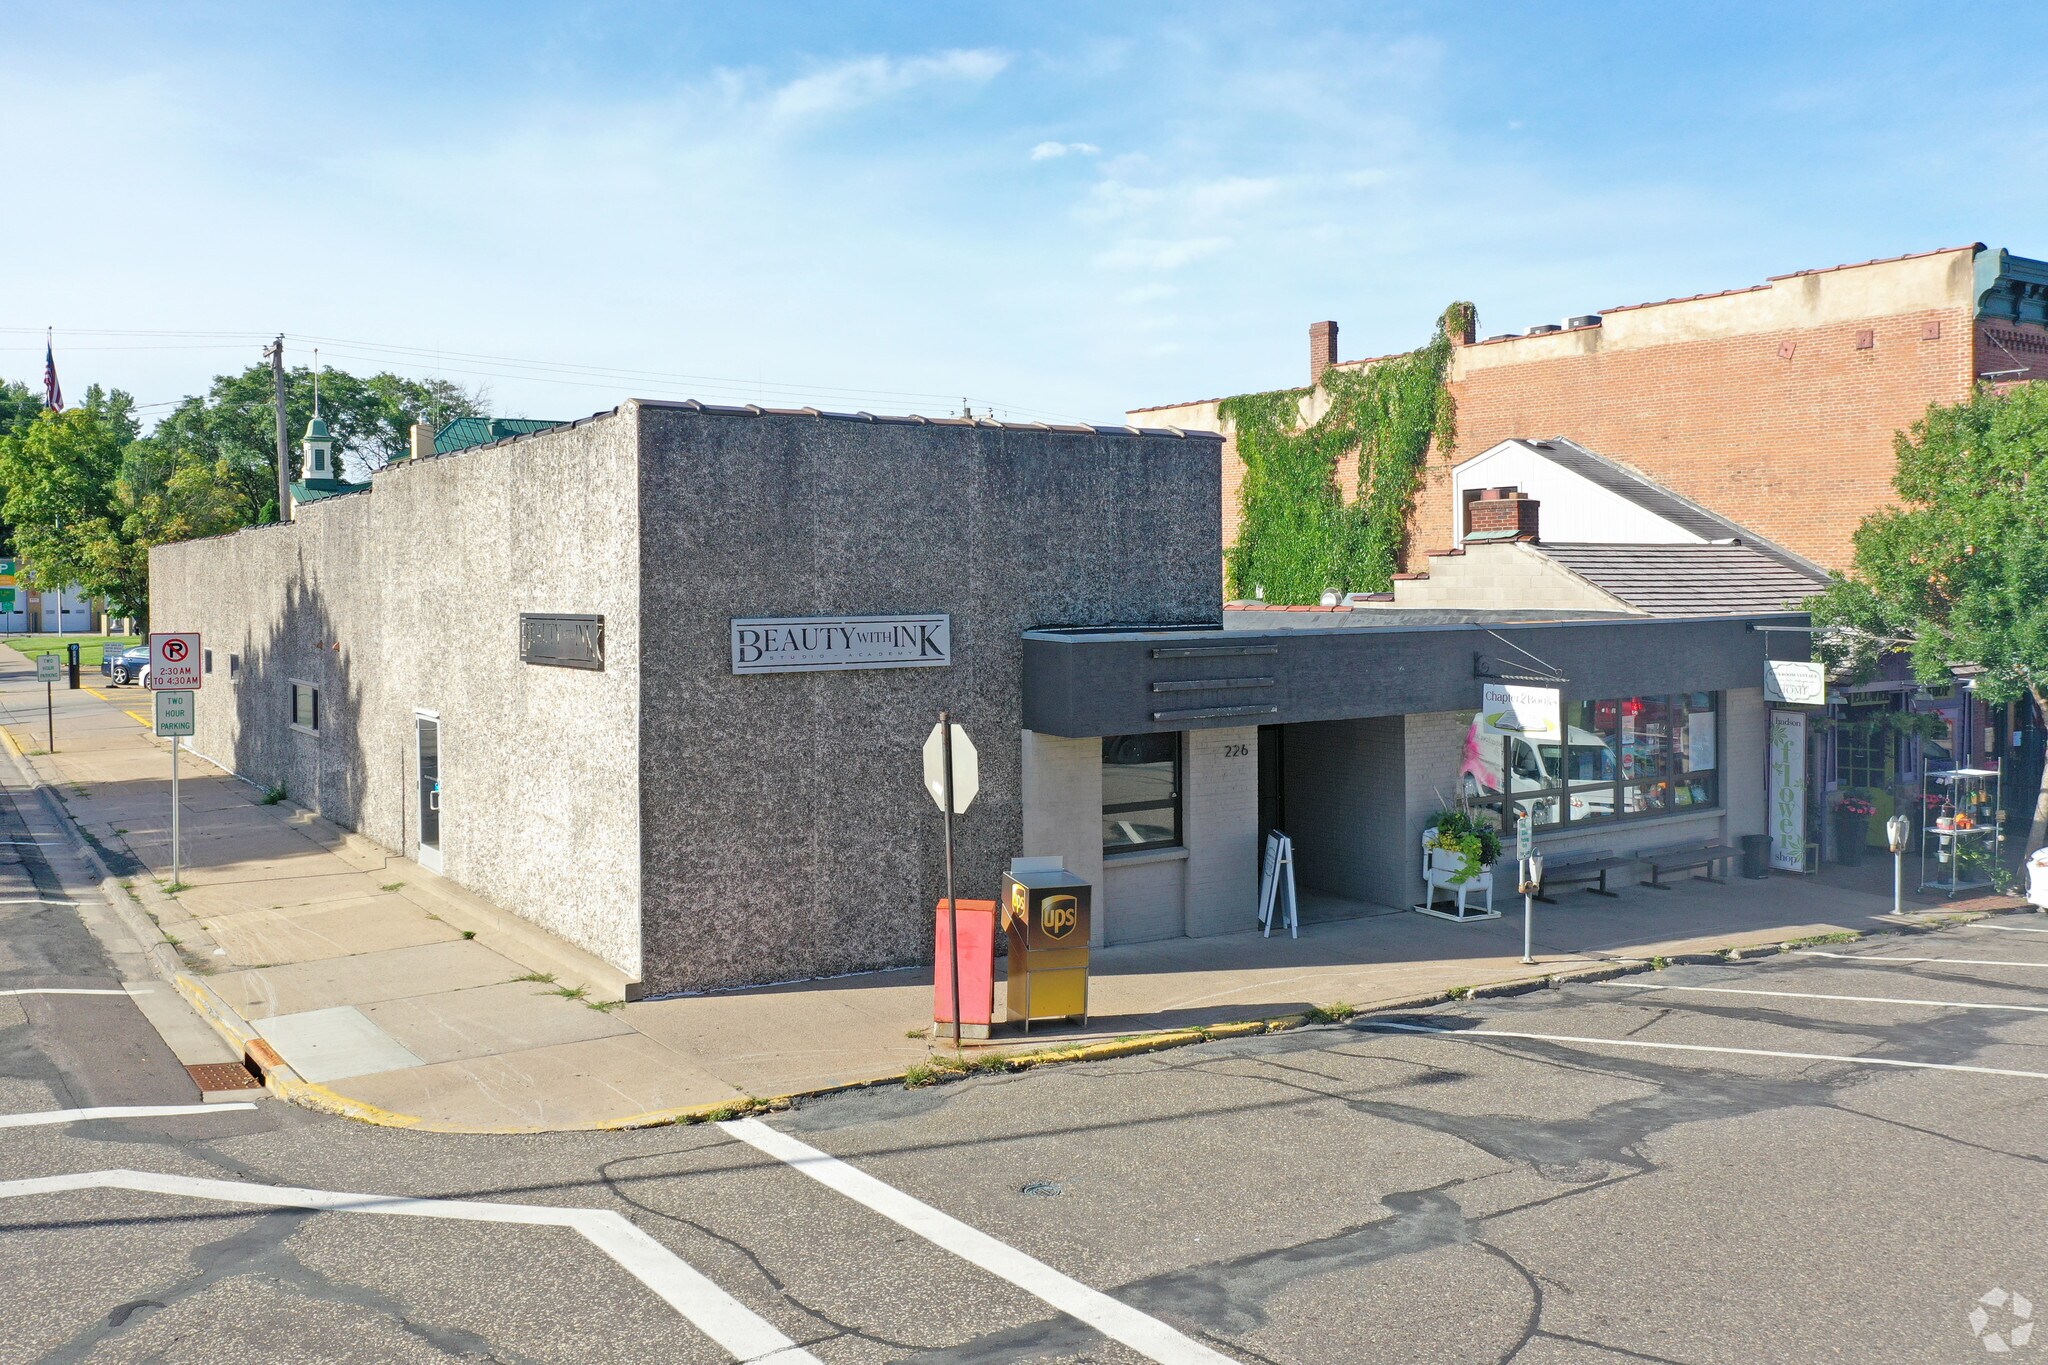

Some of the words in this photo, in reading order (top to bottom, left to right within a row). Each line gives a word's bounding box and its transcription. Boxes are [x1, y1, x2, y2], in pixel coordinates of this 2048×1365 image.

[737, 627, 856, 663] BEAUTY
[857, 631, 892, 644] WITH
[893, 624, 945, 656] INK
[160, 667, 178, 676] 2:30
[179, 667, 192, 675] AM
[153, 677, 164, 685] TO
[166, 676, 186, 685] 4:30
[186, 676, 199, 684] AM
[168, 697, 184, 705] TWO
[165, 709, 185, 718] HOUR
[160, 722, 191, 730] PARKING
[1775, 717, 1801, 727] hudson
[1224, 744, 1249, 757] 226
[1778, 740, 1796, 849] flower
[1774, 851, 1797, 867] shop
[1043, 908, 1075, 934] ups
